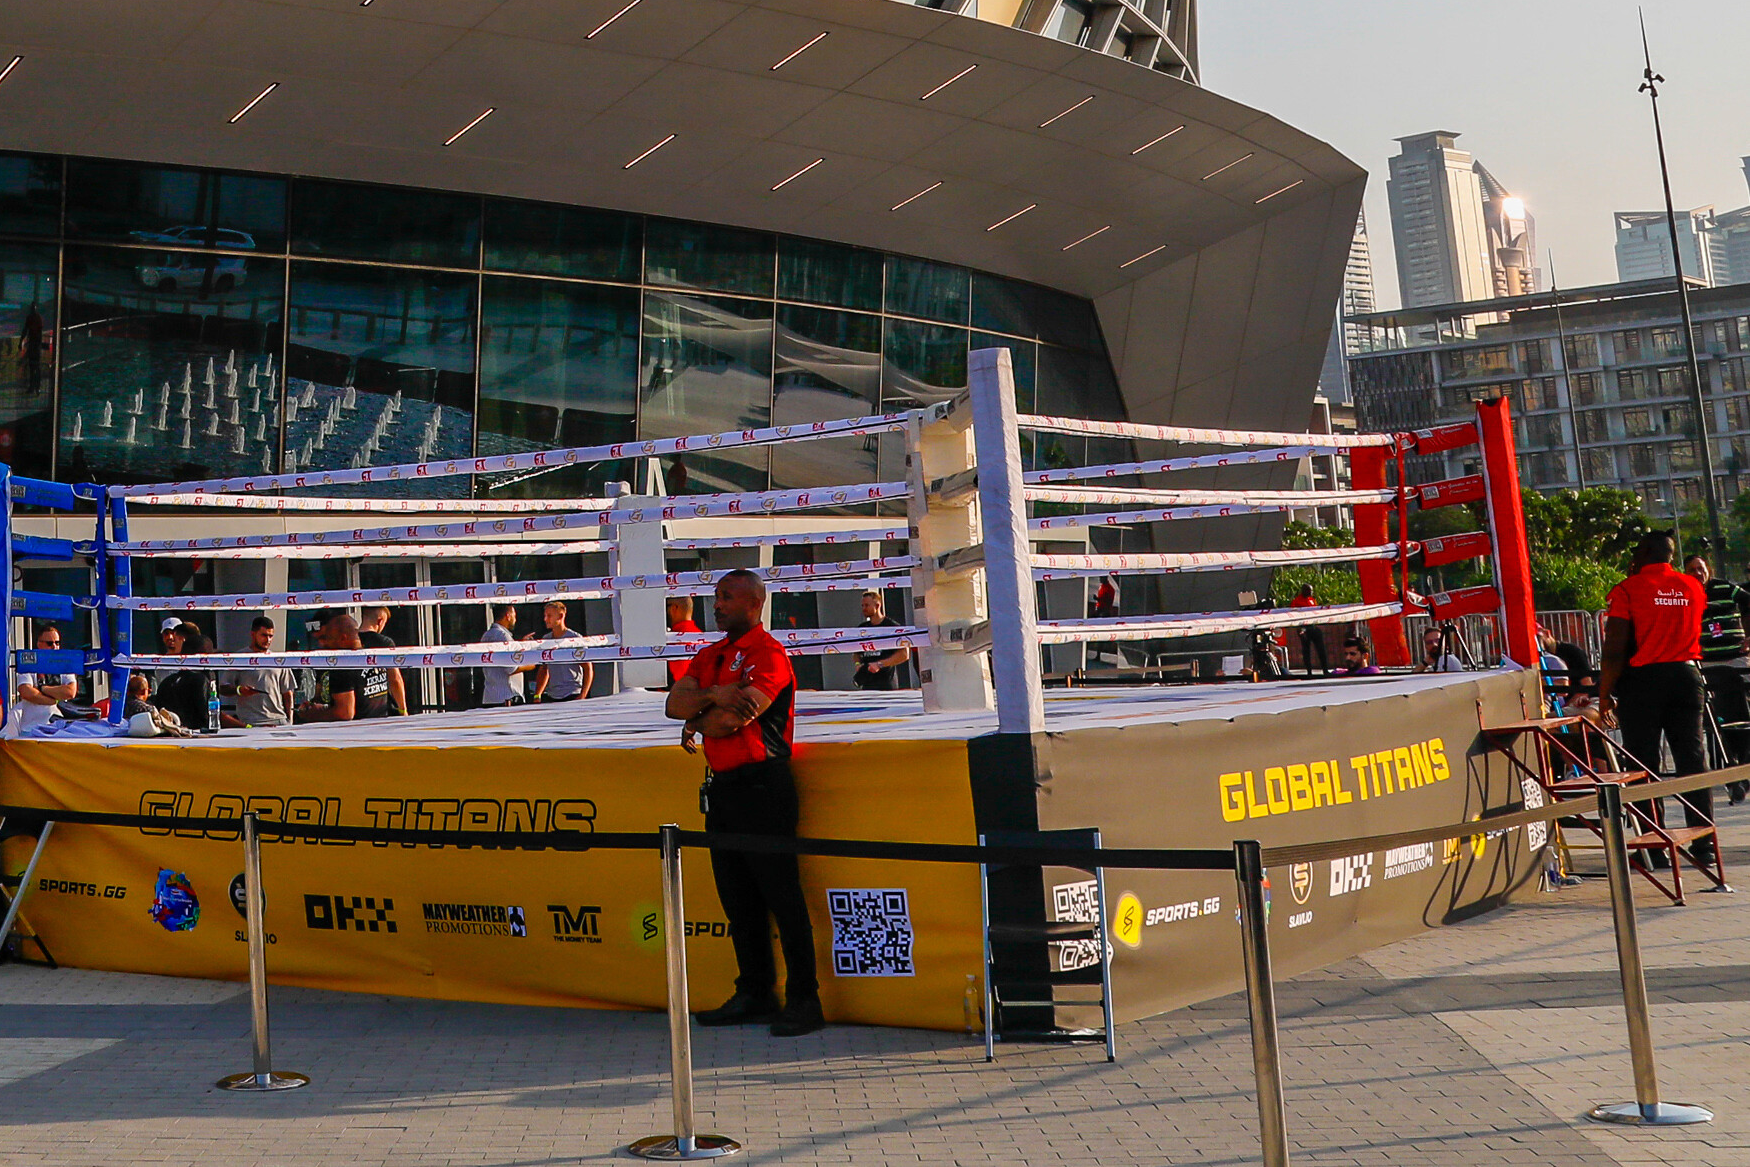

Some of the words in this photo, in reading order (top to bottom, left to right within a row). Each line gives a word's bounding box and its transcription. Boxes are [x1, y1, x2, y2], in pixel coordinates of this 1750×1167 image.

[1653, 598, 1689, 606] SECURITY
[1219, 759, 1353, 822] GLOBAL
[1350, 737, 1450, 801] TITANS
[139, 790, 356, 847] GLOBAL
[365, 797, 597, 852] TITANS
[1383, 858, 1426, 880] PROMOTIONS
[39, 878, 127, 899] SPORTS.GG
[422, 903, 507, 923] MAYWEATHER
[1145, 896, 1220, 926] SPORTS.GG
[425, 921, 510, 937] PROMOTIONS
